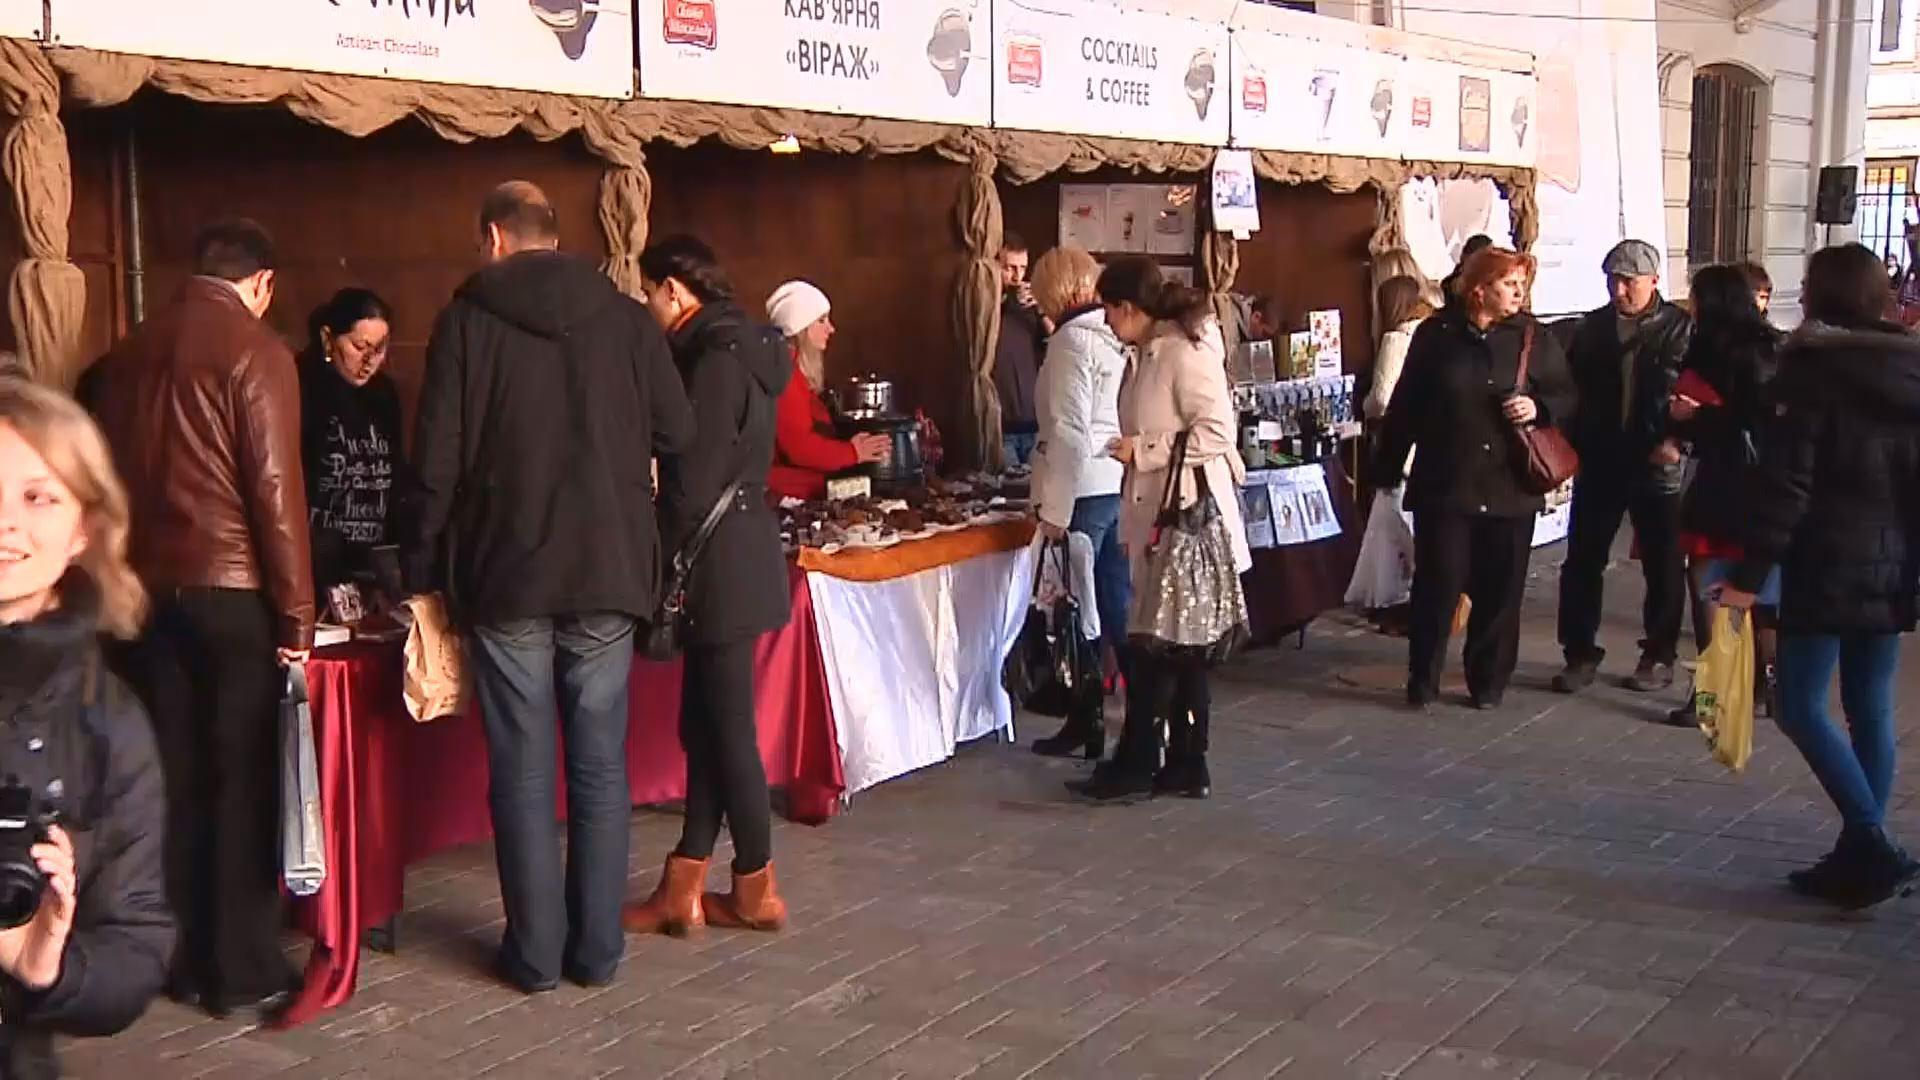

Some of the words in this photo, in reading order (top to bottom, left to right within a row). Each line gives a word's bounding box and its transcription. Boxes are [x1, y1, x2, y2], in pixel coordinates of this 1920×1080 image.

[786, 39, 880, 80] «ВІРАЖ»
[1081, 37, 1158, 70] COCKTAILS
[1086, 77, 1094, 100] &
[1100, 79, 1150, 106] COFFEE
